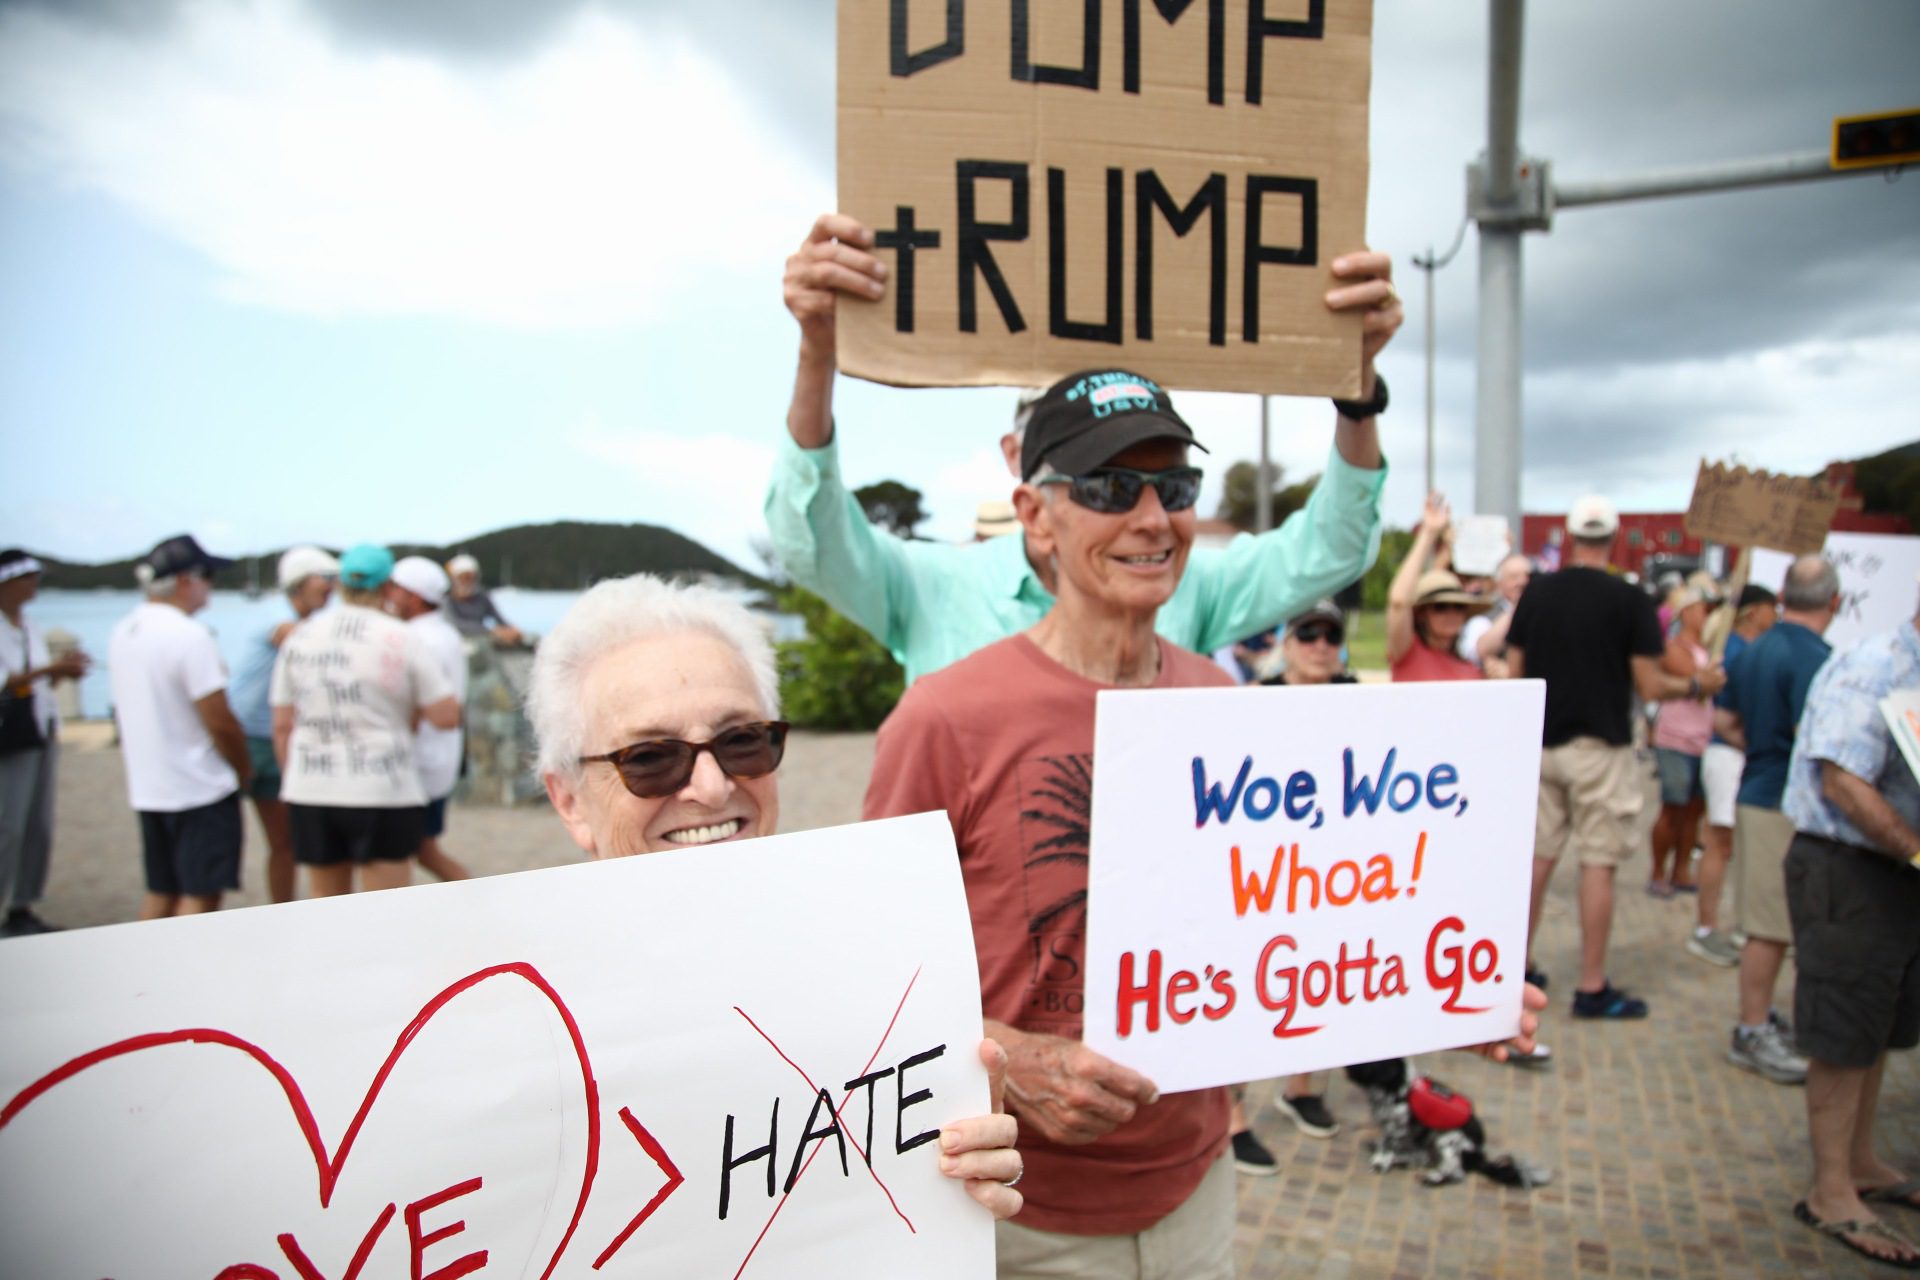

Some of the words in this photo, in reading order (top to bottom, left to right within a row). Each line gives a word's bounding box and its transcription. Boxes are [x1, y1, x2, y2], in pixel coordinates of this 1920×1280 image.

[874, 159, 1320, 347] tRUMP
[1192, 755, 1325, 829] Woe,
[1342, 747, 1468, 818] Woe,
[1230, 831, 1427, 918] Whoa!
[1116, 948, 1237, 1039] He's
[1255, 935, 1408, 1039] Gotta
[1425, 916, 1503, 1014] Go.
[719, 1043, 947, 1220] HATE
